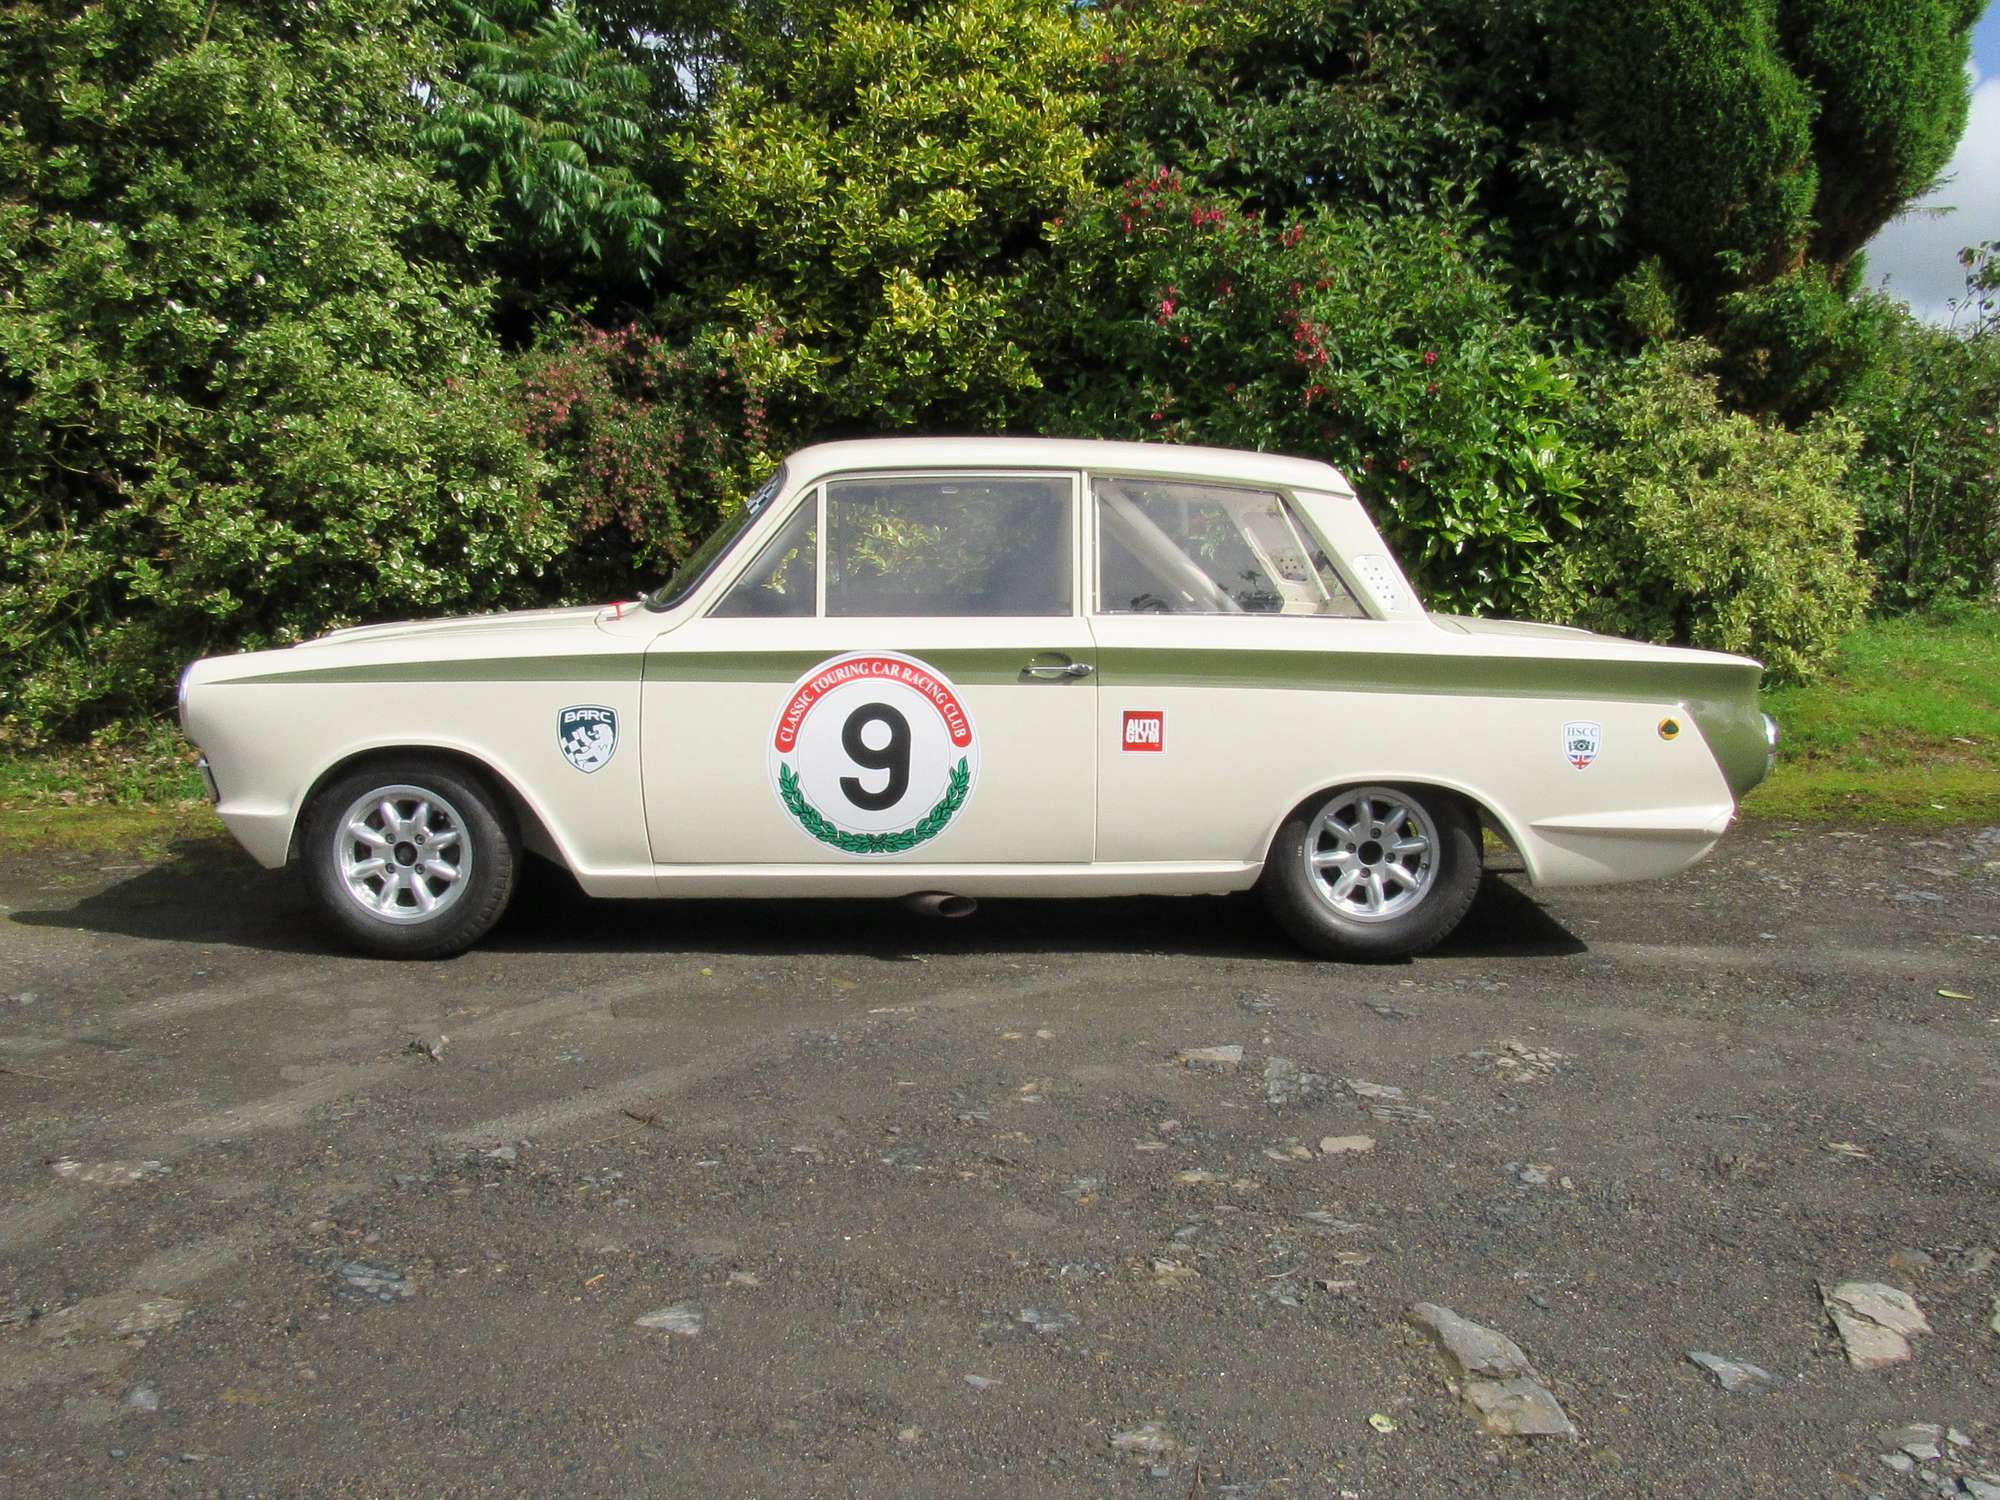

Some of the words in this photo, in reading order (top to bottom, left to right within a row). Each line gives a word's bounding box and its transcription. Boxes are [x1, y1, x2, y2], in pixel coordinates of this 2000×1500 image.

[780, 690, 815, 742] CLASSIC
[810, 662, 869, 694] TOURING
[871, 662, 900, 676] CAR
[901, 667, 948, 704] RACING
[943, 703, 967, 738] CLUB
[564, 710, 612, 723] BARC
[1126, 719, 1159, 731] AUTO
[1126, 731, 1159, 743] GLYM
[1567, 727, 1597, 736] HSCC
[840, 702, 911, 811] 9
